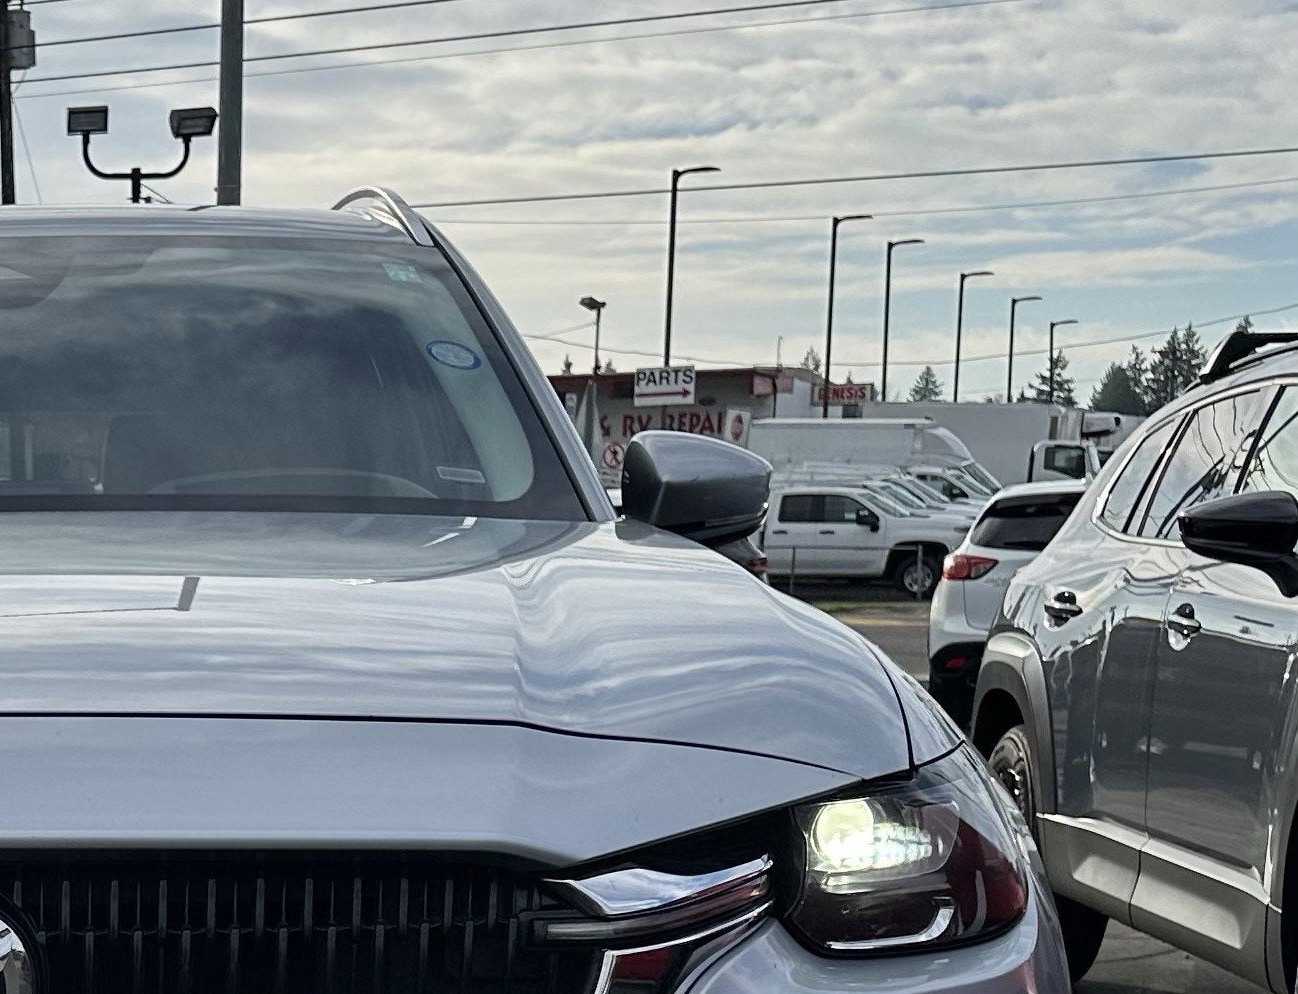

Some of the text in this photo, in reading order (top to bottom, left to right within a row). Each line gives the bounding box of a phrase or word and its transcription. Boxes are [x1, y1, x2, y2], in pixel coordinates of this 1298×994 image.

[636, 369, 693, 387] PARTS
[818, 386, 866, 400] GNESIS
[623, 414, 652, 437] RV
